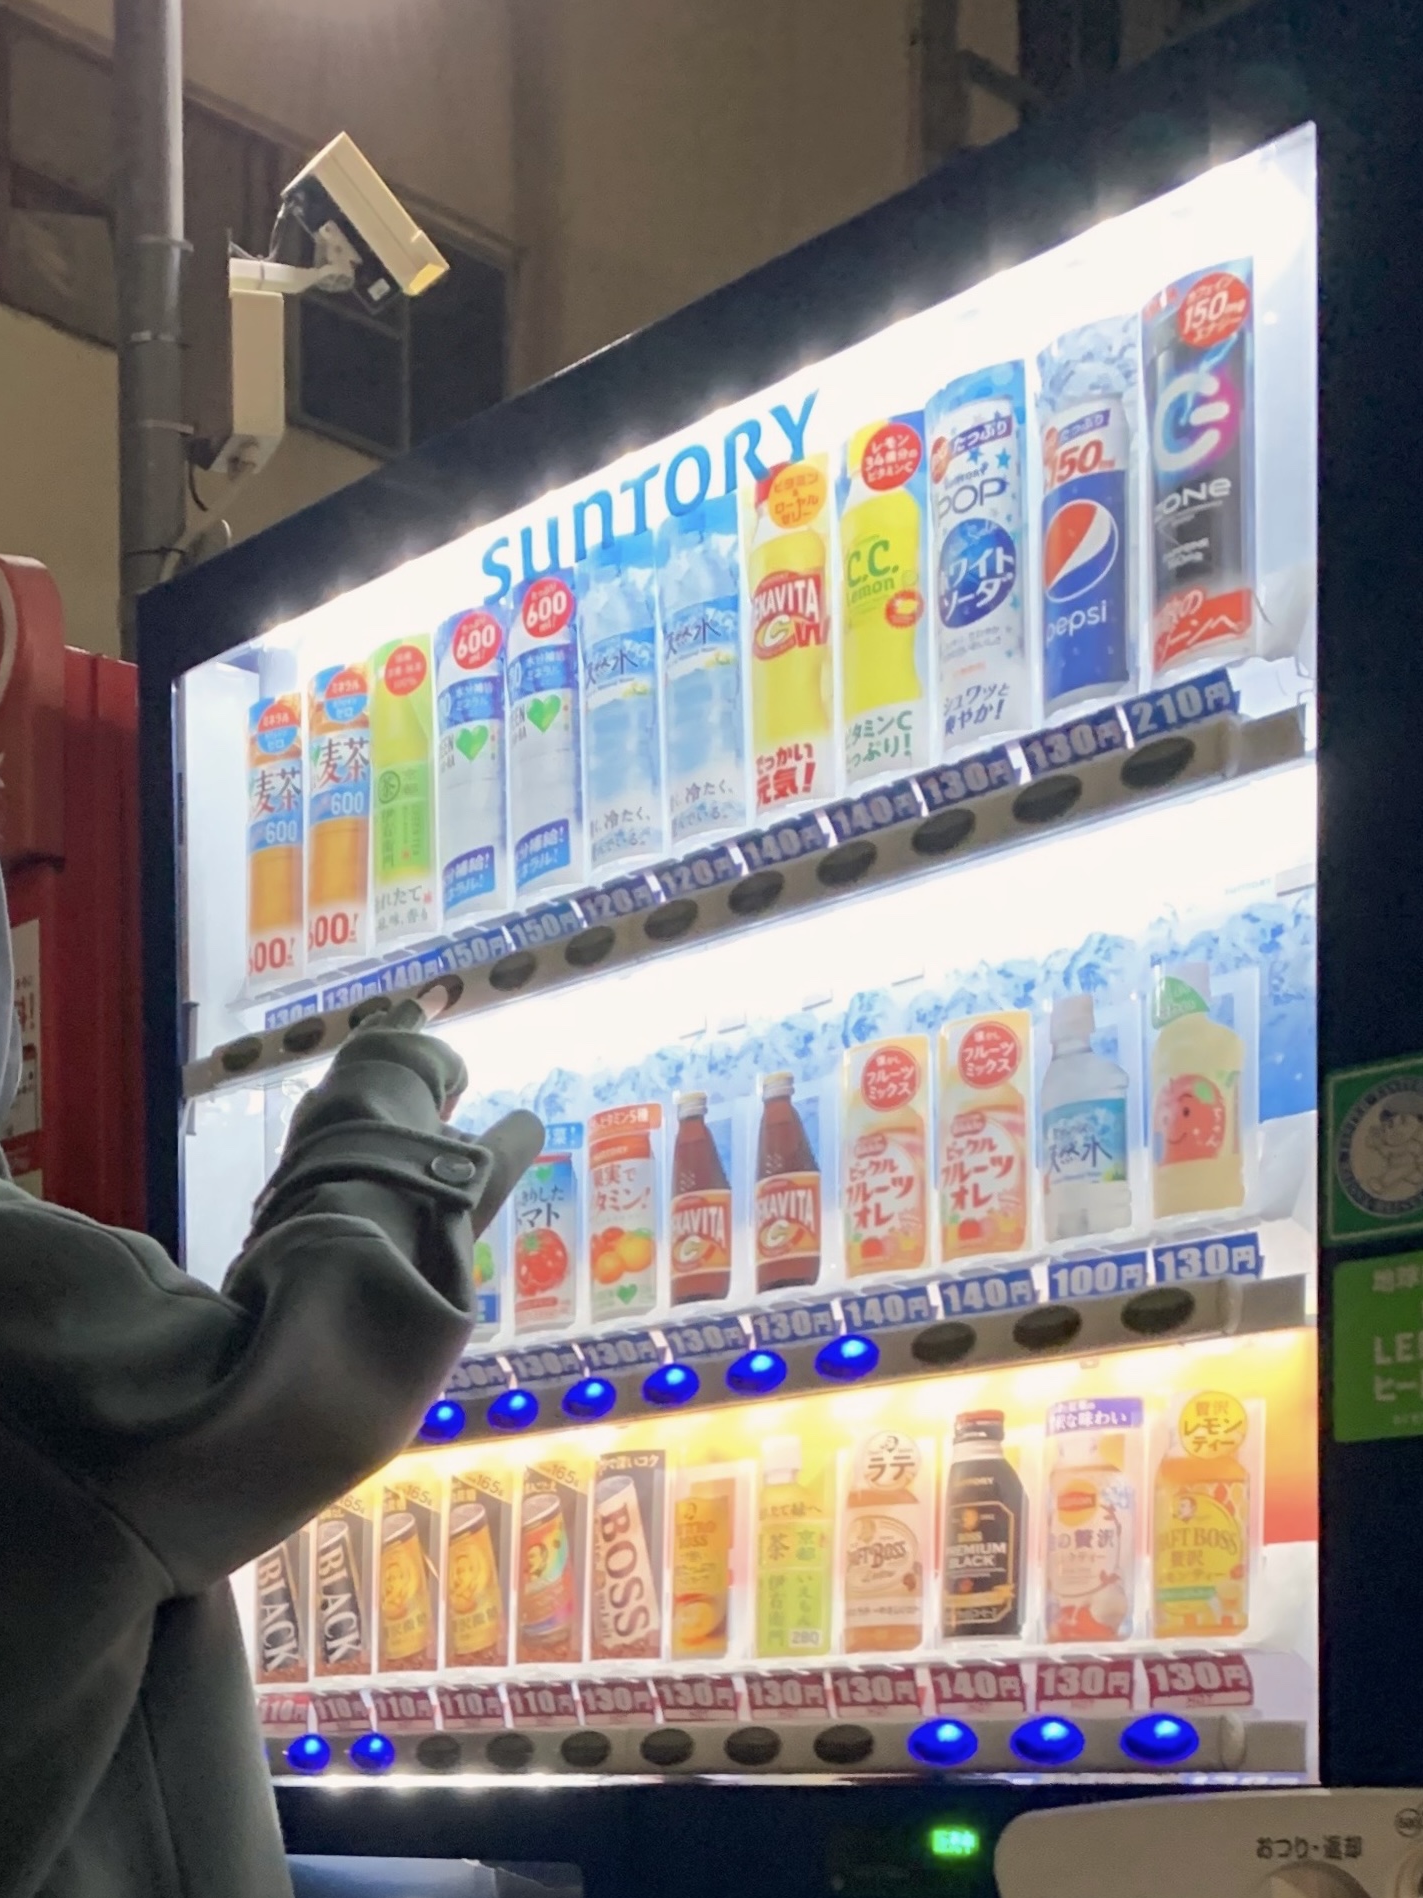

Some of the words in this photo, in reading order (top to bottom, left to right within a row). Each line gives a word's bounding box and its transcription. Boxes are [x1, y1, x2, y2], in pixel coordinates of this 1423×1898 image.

[872, 432, 912, 454] レモン
[526, 590, 568, 626] 600
[456, 624, 497, 660] 600
[1131, 680, 1231, 736] 210円
[845, 733, 912, 773] っぷり!
[1028, 720, 1122, 771] 130円
[319, 738, 370, 789] 麦茶
[252, 768, 301, 819] 麦茶
[922, 758, 1011, 806] 130円
[330, 790, 365, 817] 600
[834, 793, 913, 840] 140円
[264, 819, 298, 847] 600
[744, 824, 820, 869] 140円
[661, 854, 734, 899] 120円
[578, 883, 651, 925] 120円
[514, 911, 578, 948] 150円
[445, 934, 504, 972] 150円
[381, 960, 441, 994] 140円
[327, 979, 379, 1010] 130円
[963, 1041, 1015, 1062] フルーツ
[866, 1065, 915, 1085] フルーツ
[965, 1058, 1012, 1078] ミックス
[867, 1080, 913, 1101] ミックス
[940, 1154, 1016, 1188] フルーツ
[846, 1175, 915, 1208] フルーツ
[949, 1182, 994, 1212] オレ
[853, 1202, 895, 1231] オレ
[1157, 1242, 1258, 1283] 130円
[943, 1276, 1034, 1314] 140円
[1051, 1261, 1146, 1298] 100円
[753, 1309, 832, 1340] 130円
[849, 1293, 930, 1328] 140円
[587, 1341, 654, 1368] 130円
[668, 1324, 743, 1355] 130円
[513, 1351, 576, 1379] 130円
[1183, 1416, 1243, 1436] レモン
[1192, 1436, 1235, 1452] ティー
[867, 1454, 916, 1482] ラテ
[601, 1503, 651, 1638] BOSS
[256, 1557, 301, 1673] BLACK
[317, 1543, 363, 1665] BLACK
[750, 1675, 826, 1706] 130円
[834, 1675, 917, 1703] 130円
[934, 1670, 1023, 1699] 140円
[1042, 1664, 1131, 1698] 130円
[1150, 1660, 1250, 1693] 130円
[379, 1695, 435, 1718] 110円
[444, 1693, 505, 1716] 110円
[510, 1691, 575, 1714] 110円
[582, 1687, 652, 1712] 130円
[658, 1682, 734, 1708] 130円
[1256, 1833, 1364, 1861] おつり・返却
